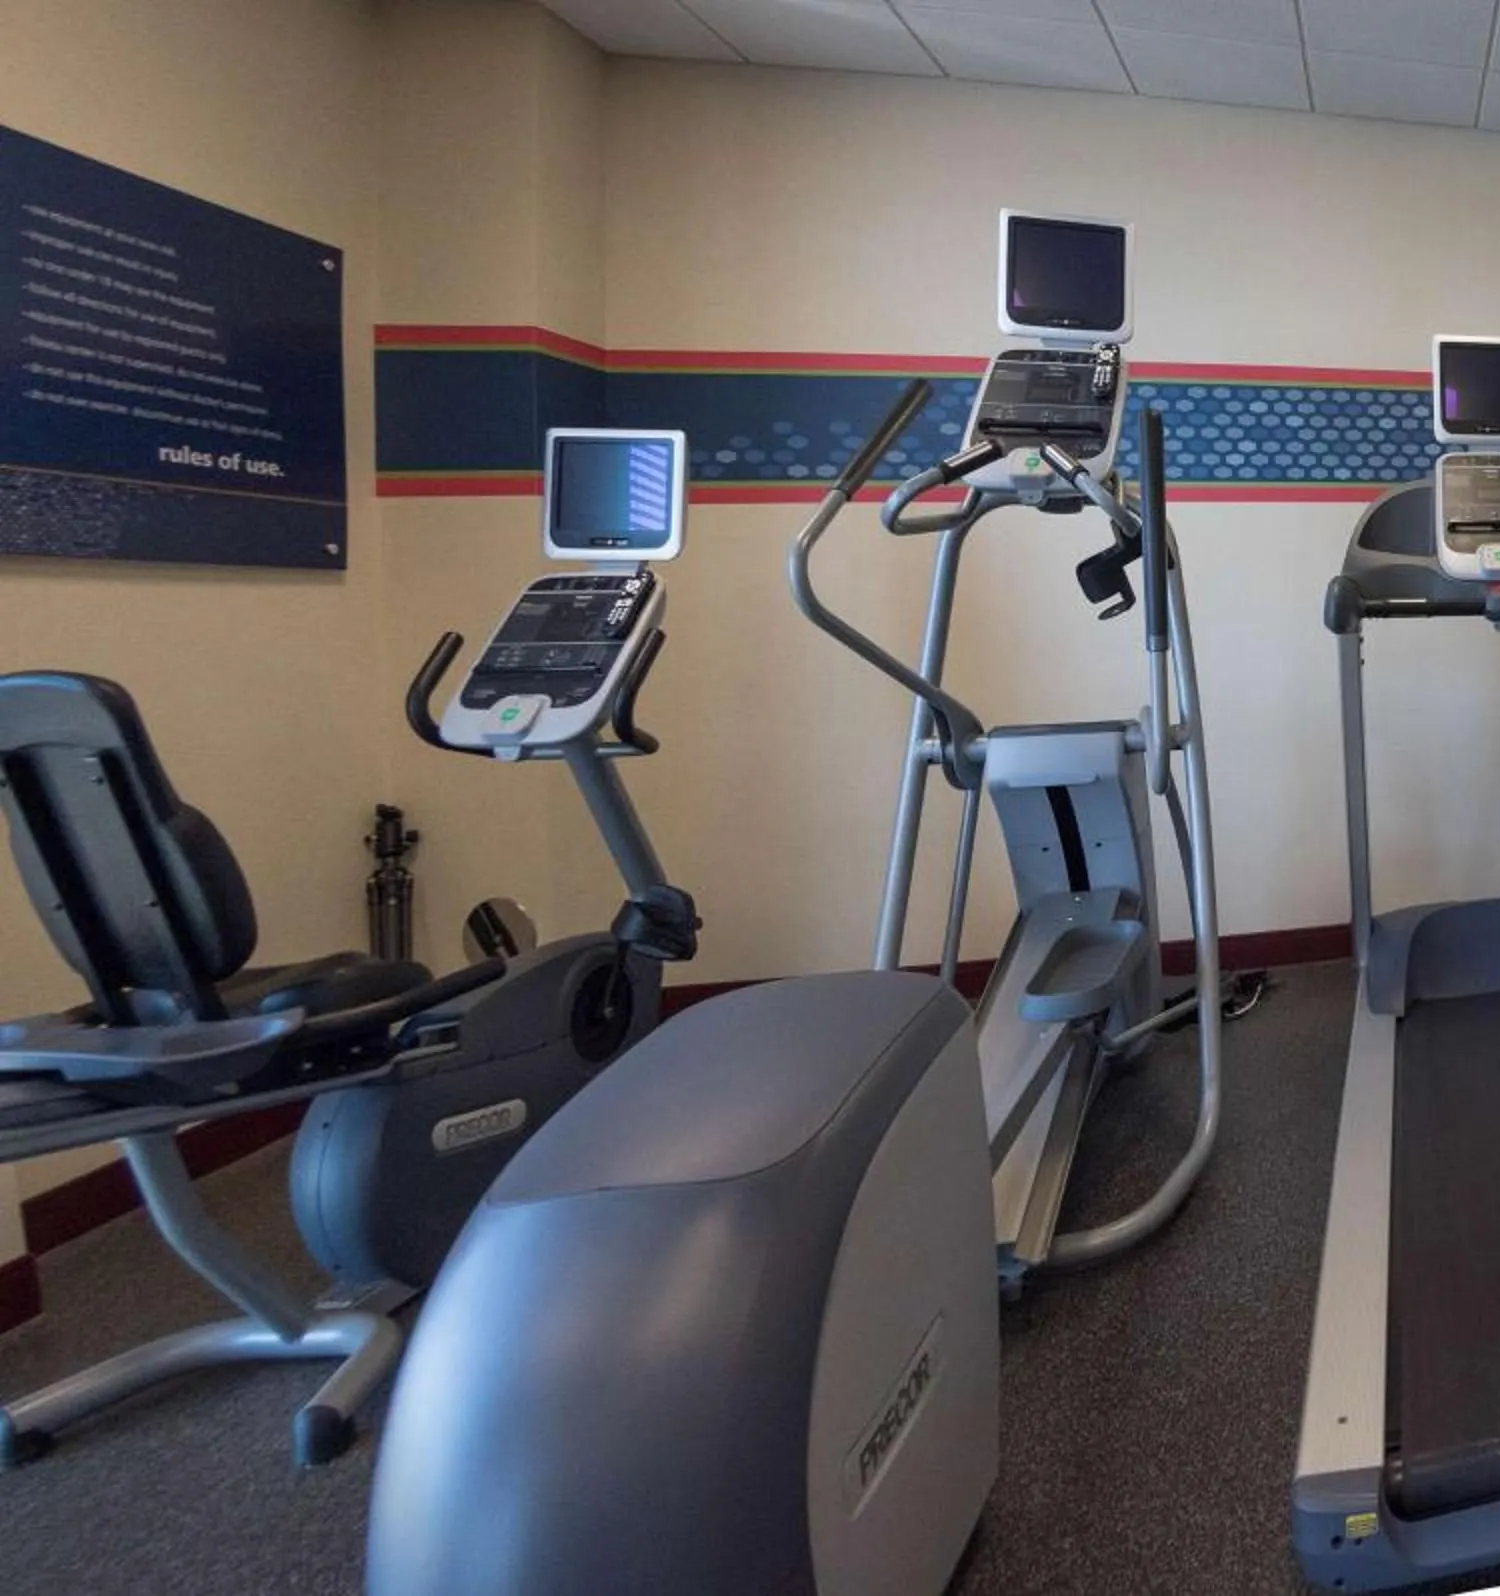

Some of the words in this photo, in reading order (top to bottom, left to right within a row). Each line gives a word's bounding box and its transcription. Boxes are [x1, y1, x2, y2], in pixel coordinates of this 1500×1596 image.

[159, 445, 214, 467] rules
[217, 452, 242, 471] of
[245, 459, 285, 477] use.
[858, 1352, 931, 1488] PRECOR
